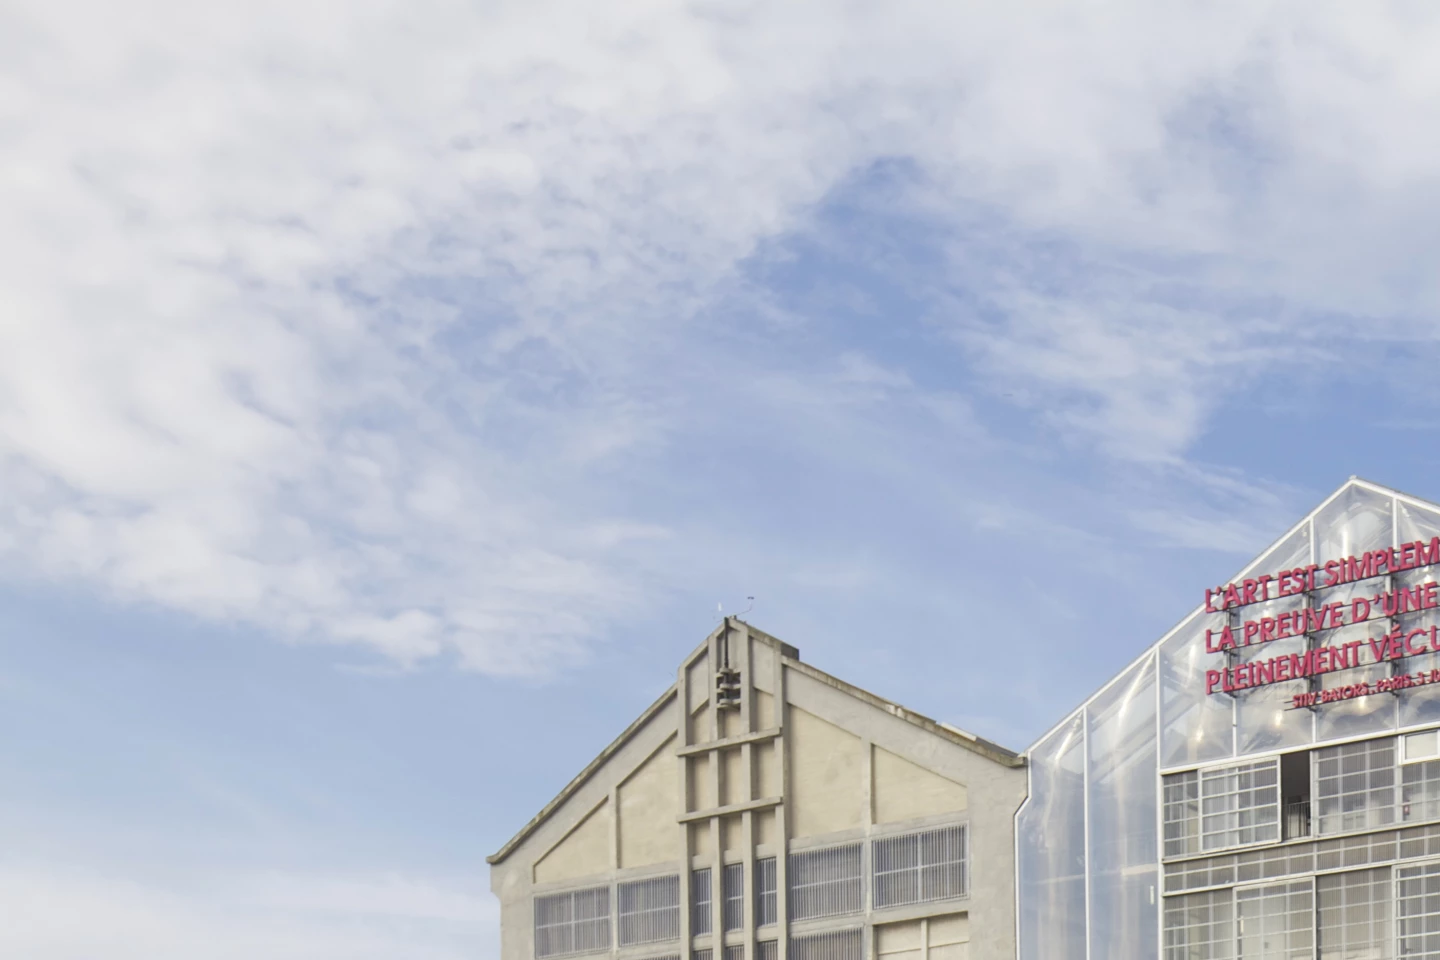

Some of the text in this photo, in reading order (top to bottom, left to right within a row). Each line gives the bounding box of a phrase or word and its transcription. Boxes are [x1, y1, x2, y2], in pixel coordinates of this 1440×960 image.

[1205, 575, 1270, 613] L'ART
[1278, 564, 1317, 597] EST
[1206, 629, 1236, 654] LA
[1244, 602, 1343, 645] PREUVE
[1352, 582, 1438, 622] D'UNE
[1206, 641, 1362, 695] PLEINEMENT
[1292, 691, 1318, 709] STIV
[1417, 671, 1424, 685] 3
